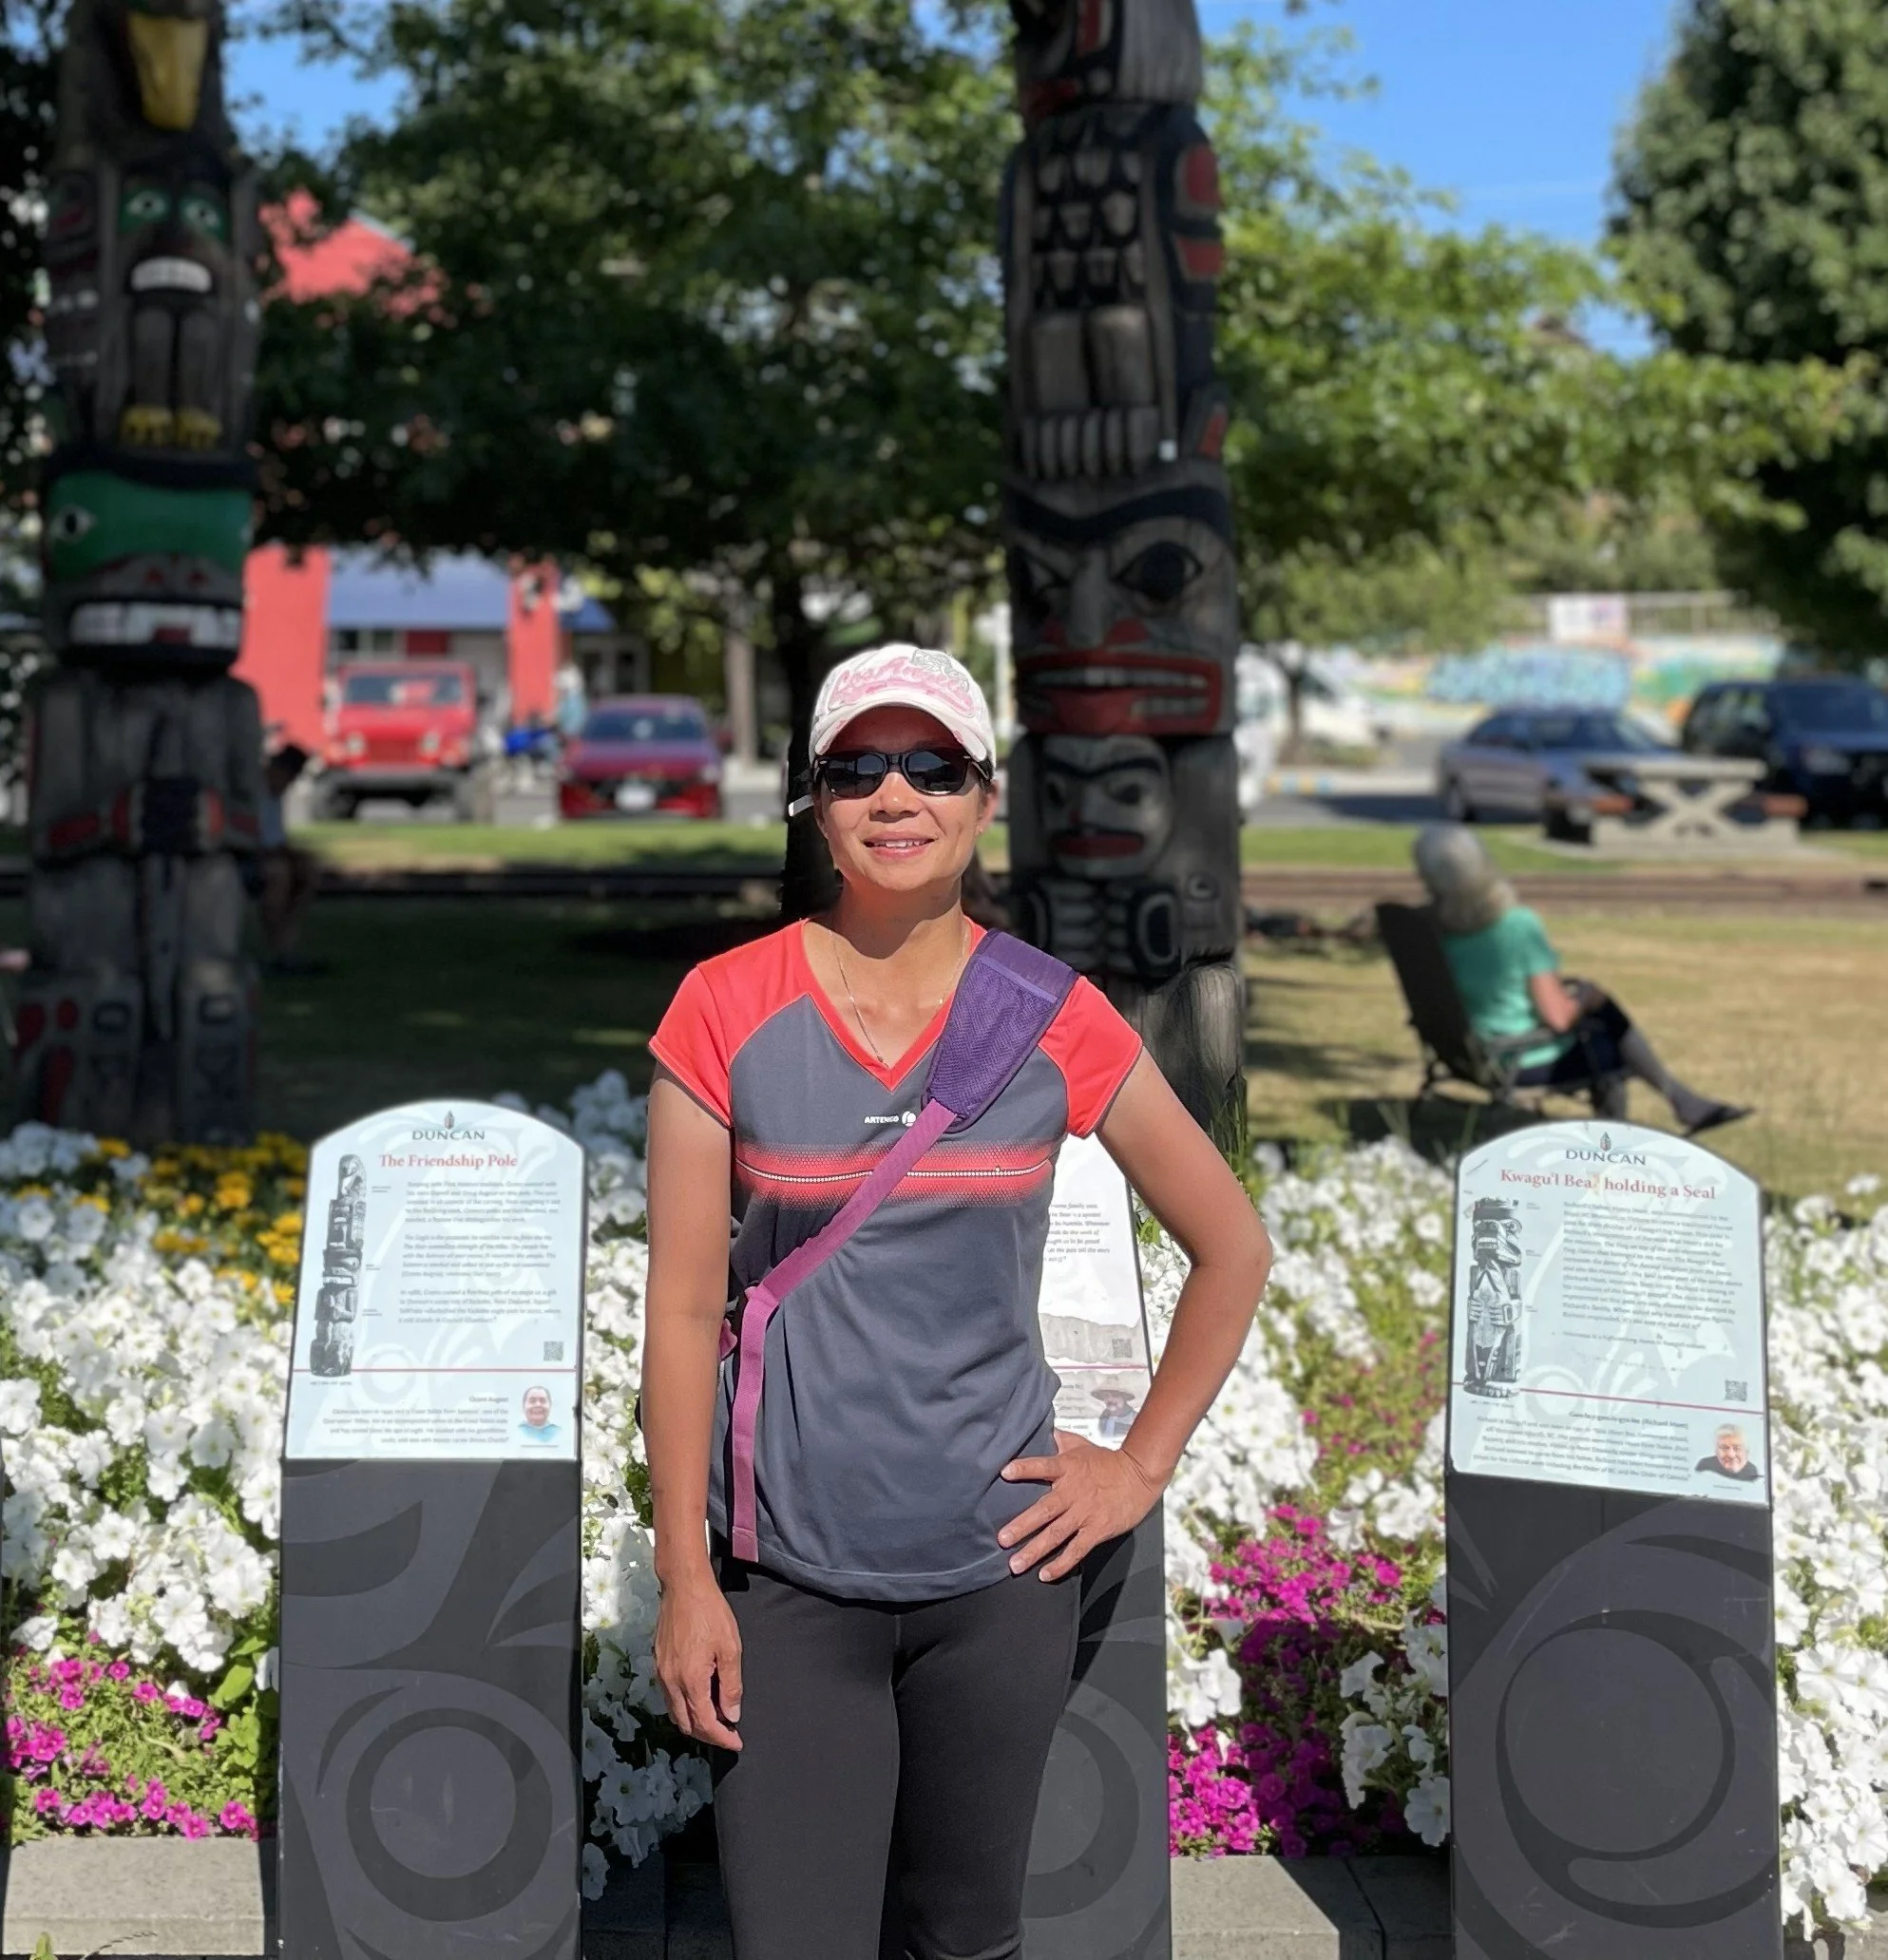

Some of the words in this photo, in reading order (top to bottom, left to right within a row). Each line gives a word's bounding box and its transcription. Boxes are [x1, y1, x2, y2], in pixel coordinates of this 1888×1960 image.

[864, 1114, 900, 1124] ARTENGO
[411, 1130, 486, 1141] DUNCAN
[378, 1153, 406, 1168] The
[408, 1153, 485, 1170] Friendship
[487, 1153, 518, 1167] Pole
[1565, 1149, 1647, 1166] DUNCAN
[1604, 1176, 1668, 1198] holding
[1669, 1187, 1680, 1197] a
[1683, 1185, 1716, 1200] Seal
